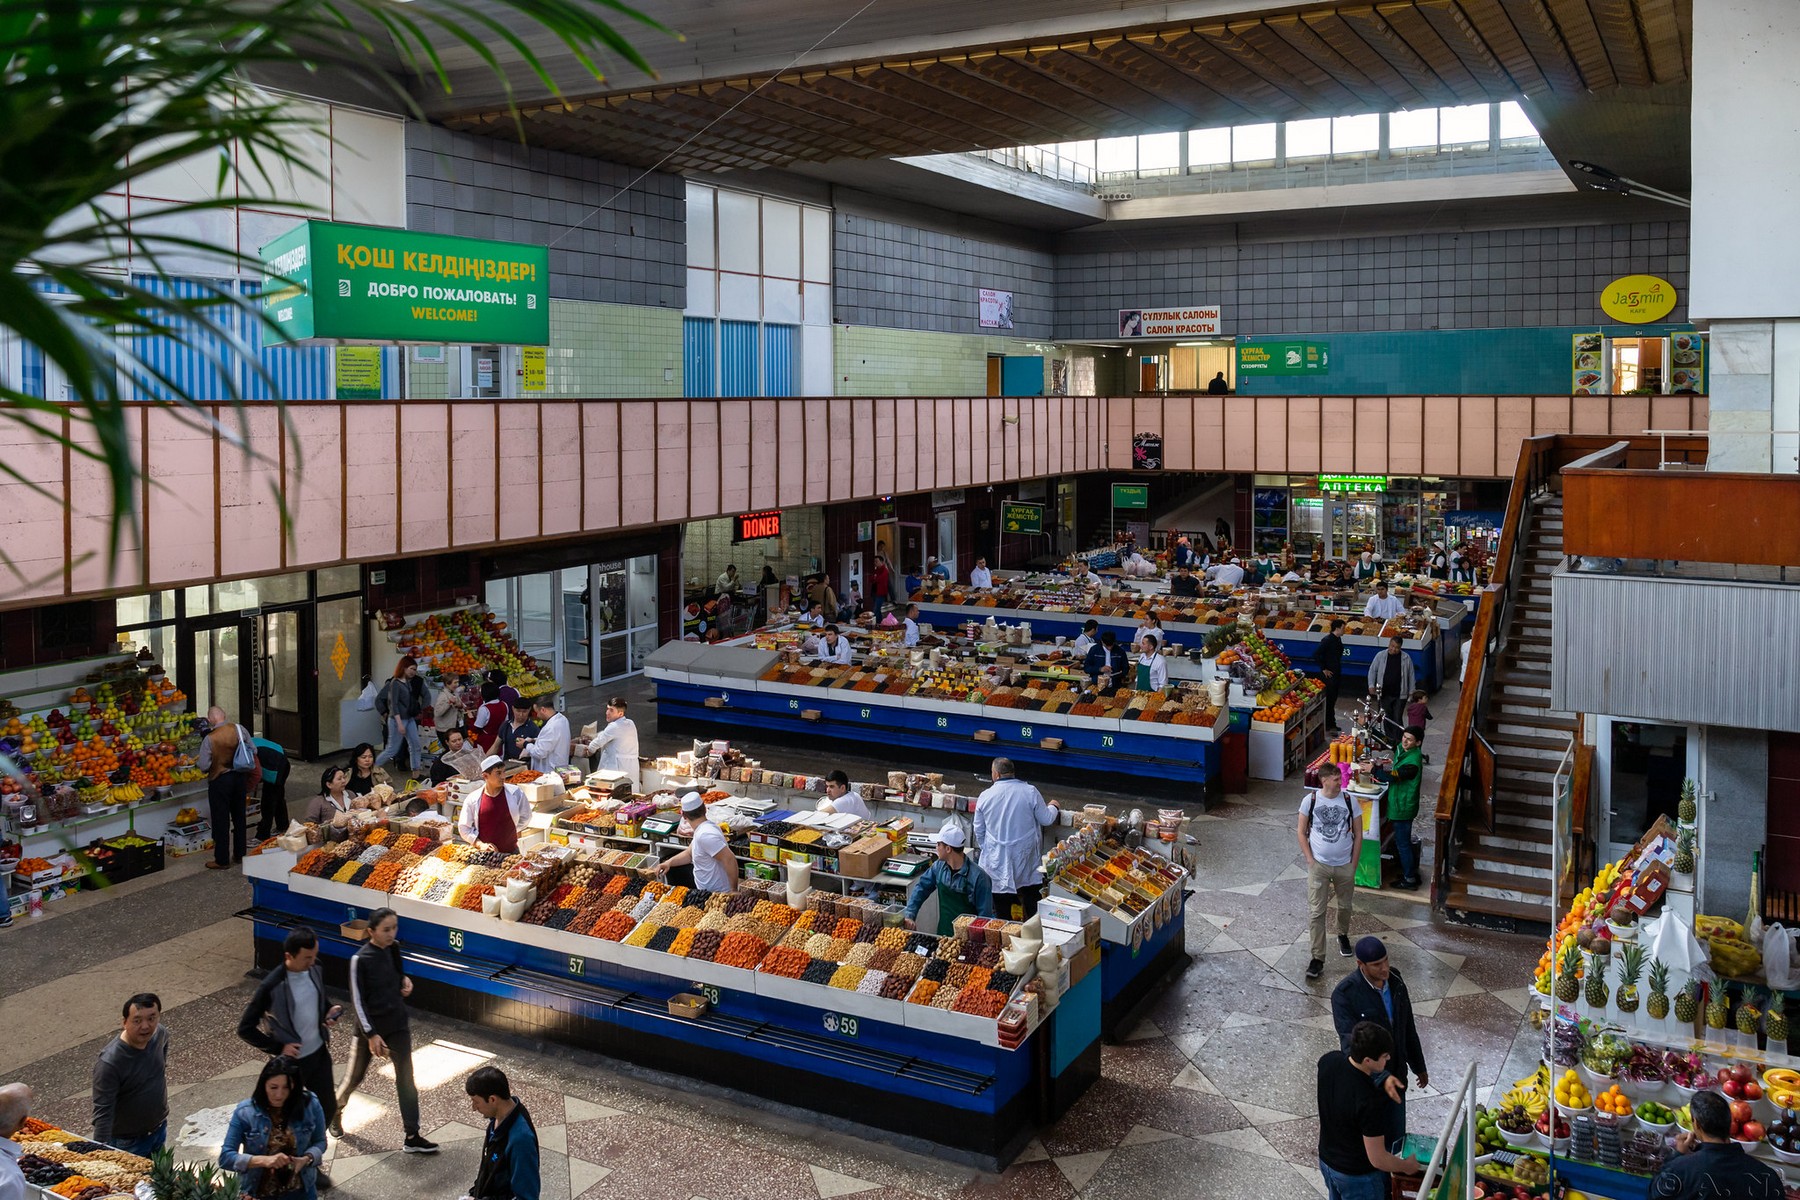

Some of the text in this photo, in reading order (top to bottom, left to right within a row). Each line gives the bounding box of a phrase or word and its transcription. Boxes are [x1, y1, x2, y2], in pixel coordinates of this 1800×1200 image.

[337, 244, 535, 283] ҚОШ КЕЛДІҢІЗДЕР!
[367, 282, 517, 305] ДОБРО ПОЖАЛОВАТЬ!
[411, 306, 478, 322] WELCOME!
[1182, 310, 1218, 320] САЛОНЫ
[1146, 324, 1215, 334] САЛОН КРАСОТЫ
[1322, 482, 1383, 492] АПТЕКА
[743, 516, 779, 539] DONER
[789, 699, 799, 709] 66
[861, 709, 870, 718] 67
[937, 717, 947, 727] 68
[1021, 726, 1032, 737] 69
[1103, 736, 1113, 746] 70
[449, 931, 463, 947] 56
[569, 957, 583, 974] 57
[703, 987, 718, 1005] 58
[840, 1016, 857, 1036] 59
